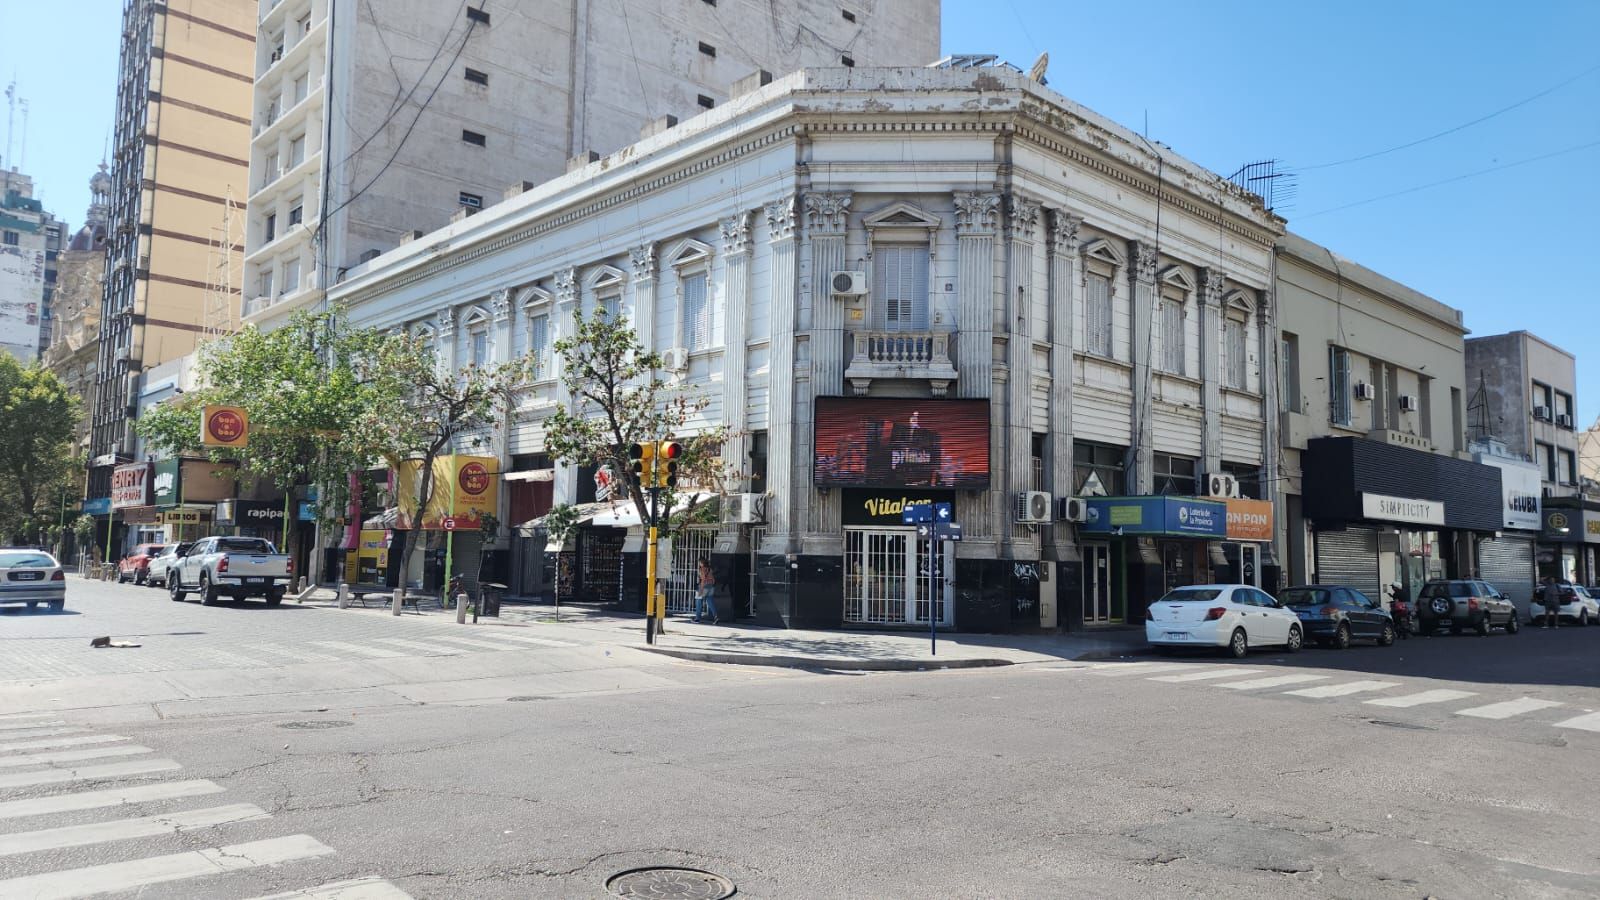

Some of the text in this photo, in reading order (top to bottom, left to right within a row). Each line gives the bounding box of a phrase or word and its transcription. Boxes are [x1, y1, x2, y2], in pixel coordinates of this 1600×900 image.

[218, 416, 235, 424] bon
[467, 480, 482, 489] bon
[1379, 500, 1430, 519] SIMPLICITY
[1243, 513, 1267, 526] PAN
